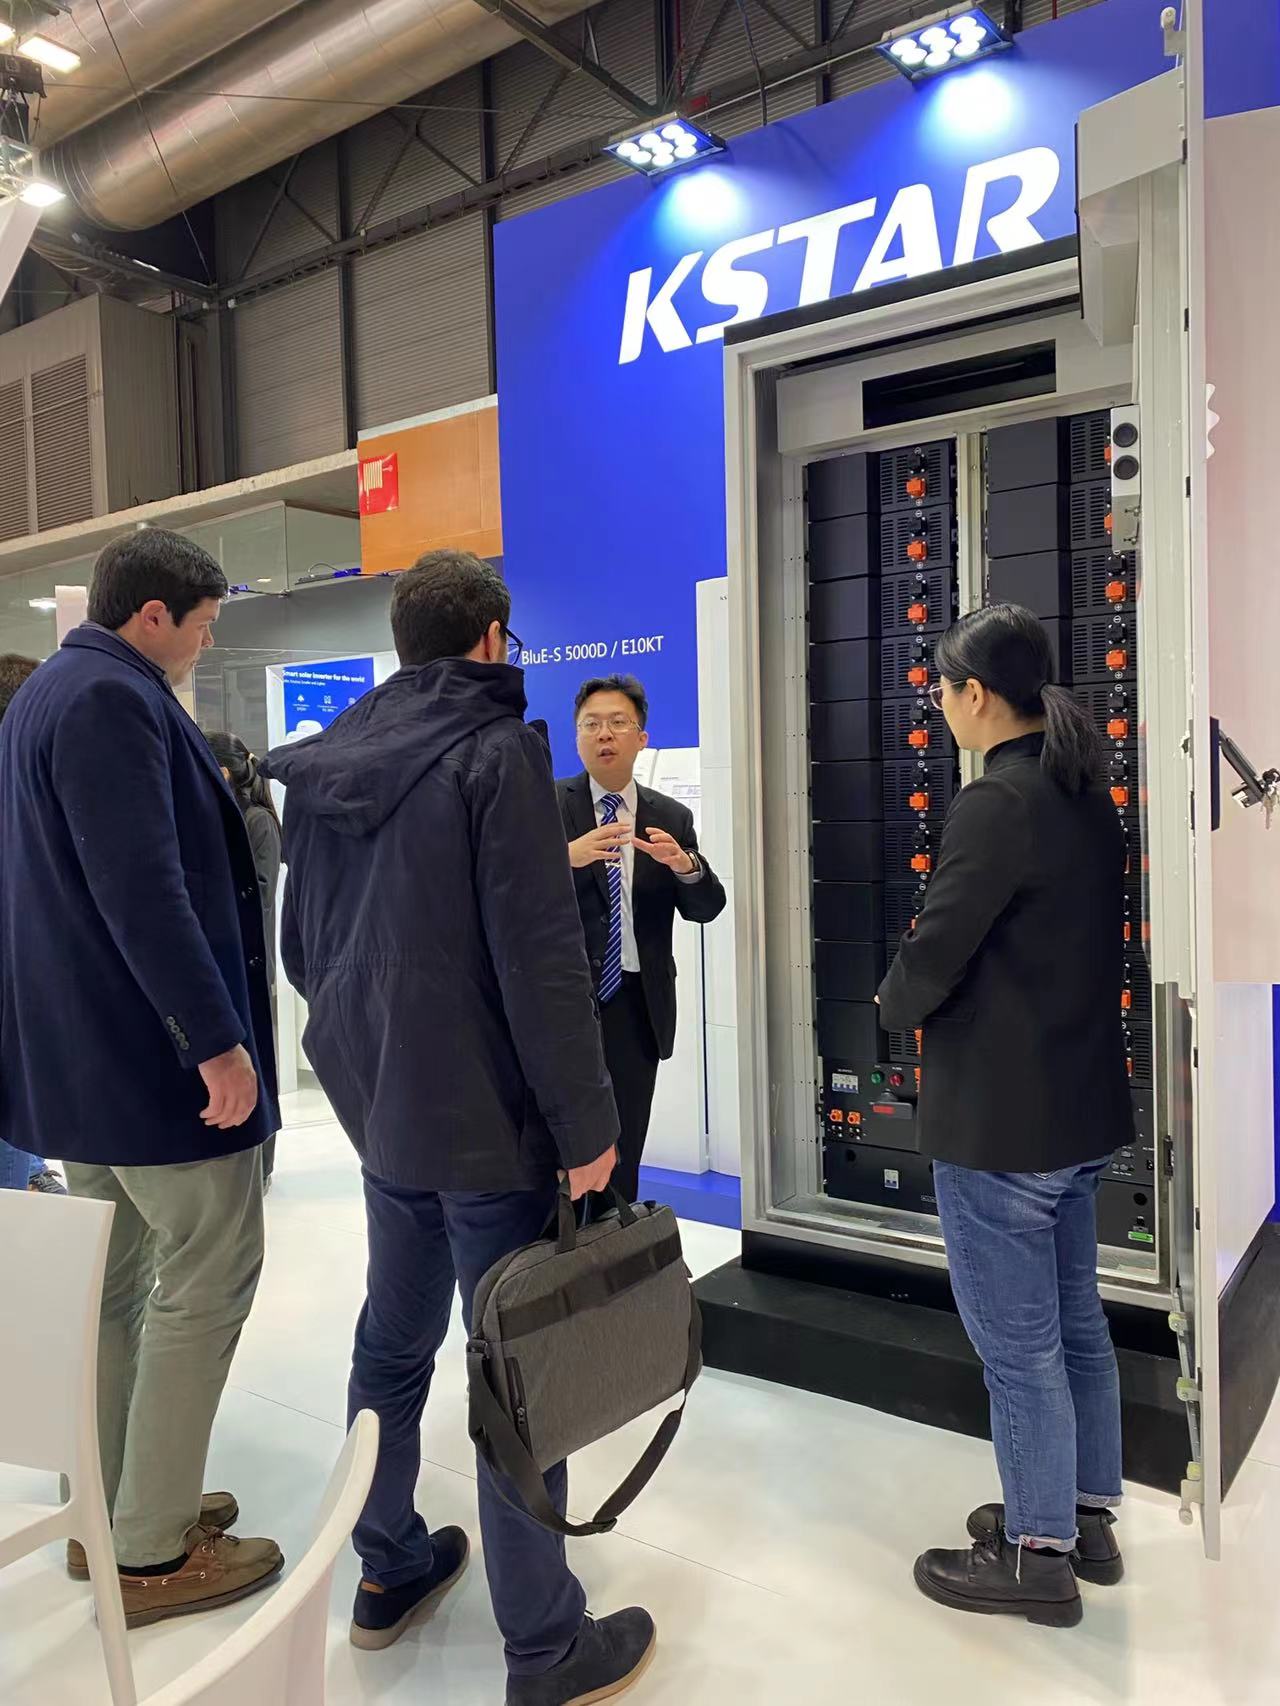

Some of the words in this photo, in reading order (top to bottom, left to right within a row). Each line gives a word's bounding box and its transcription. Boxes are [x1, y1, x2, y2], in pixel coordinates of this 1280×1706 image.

[619, 147, 1060, 364] KSTAR
[522, 647, 561, 665] BluE-S
[565, 642, 607, 661] 5000D
[610, 640, 618, 659] /
[621, 635, 664, 655] E10KT
[299, 671, 312, 679] solar
[312, 672, 332, 680] inverter
[333, 673, 342, 681] for
[341, 674, 350, 682] the
